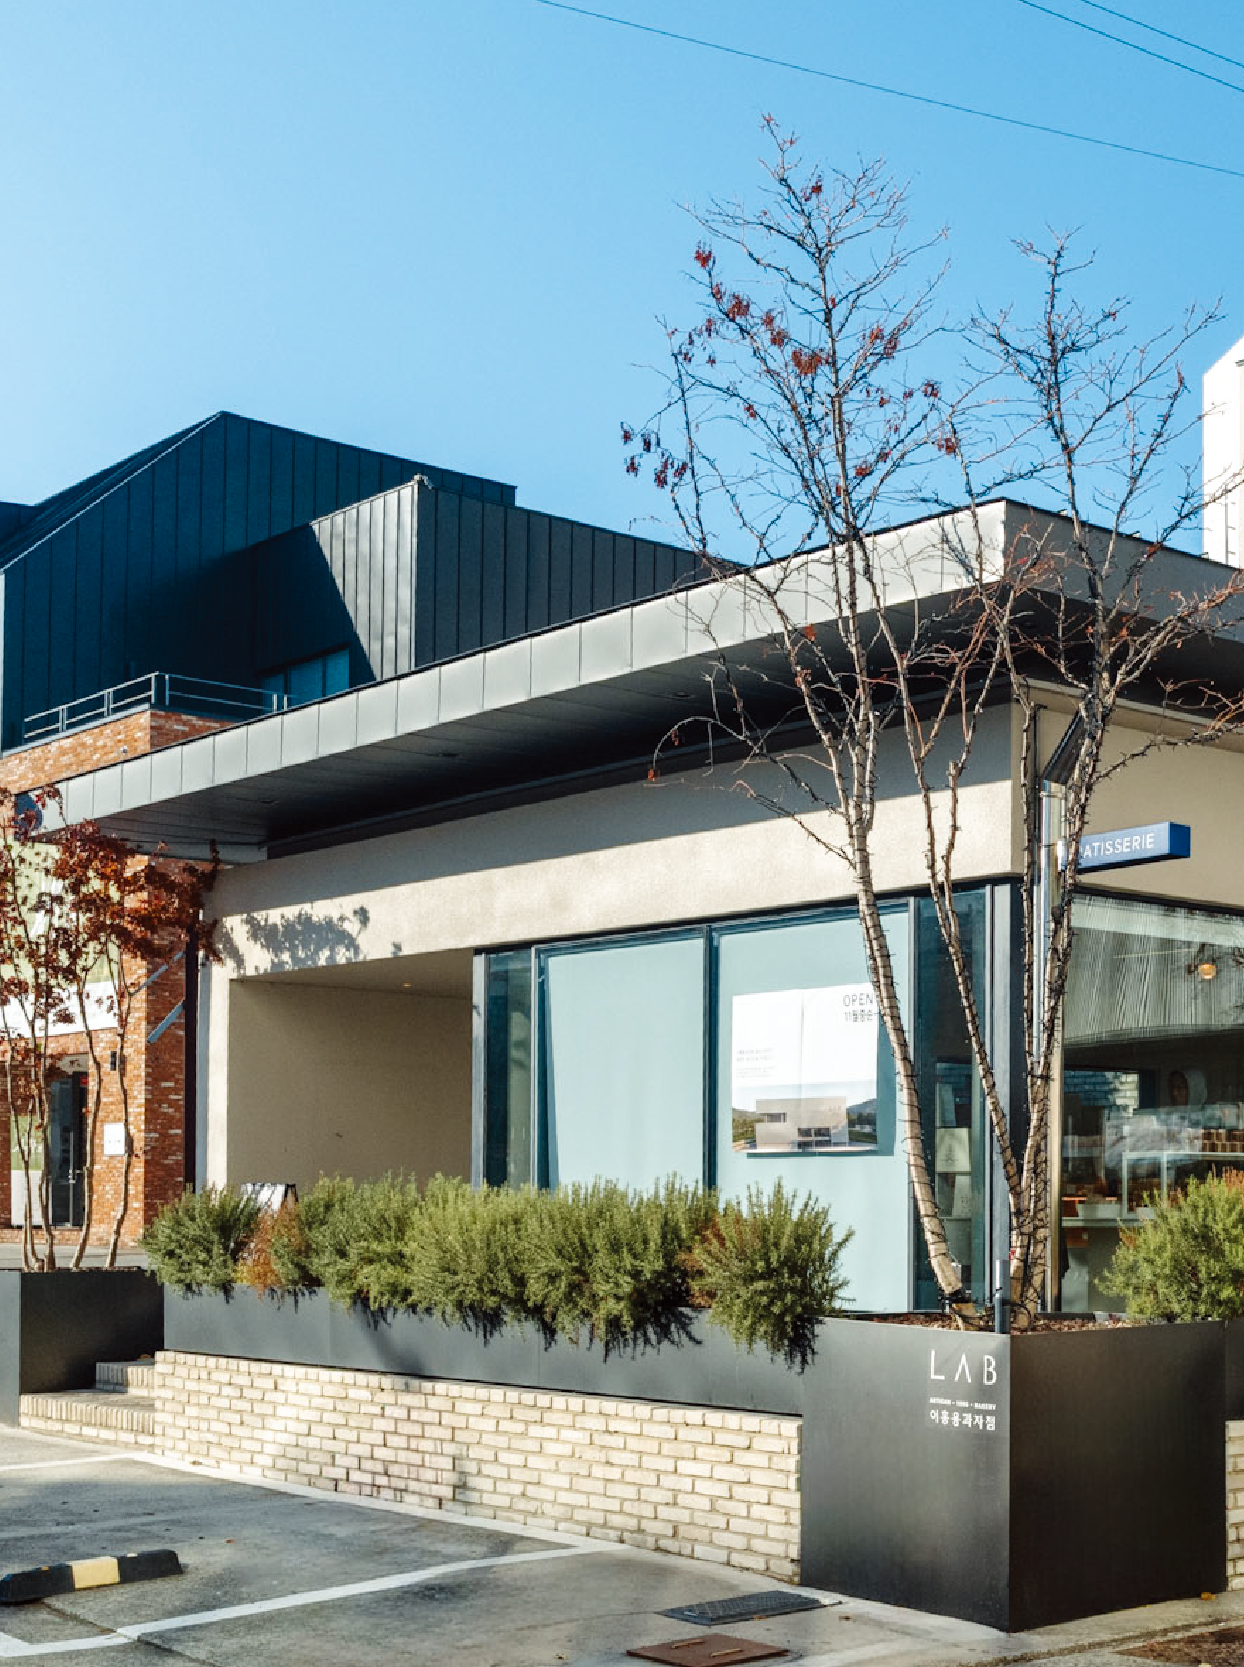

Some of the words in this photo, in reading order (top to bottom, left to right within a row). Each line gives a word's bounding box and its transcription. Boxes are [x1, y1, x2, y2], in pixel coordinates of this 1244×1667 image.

[1081, 834, 1154, 858] ATISSERIE
[843, 993, 873, 1006] OPEN
[930, 1349, 996, 1385] LAB
